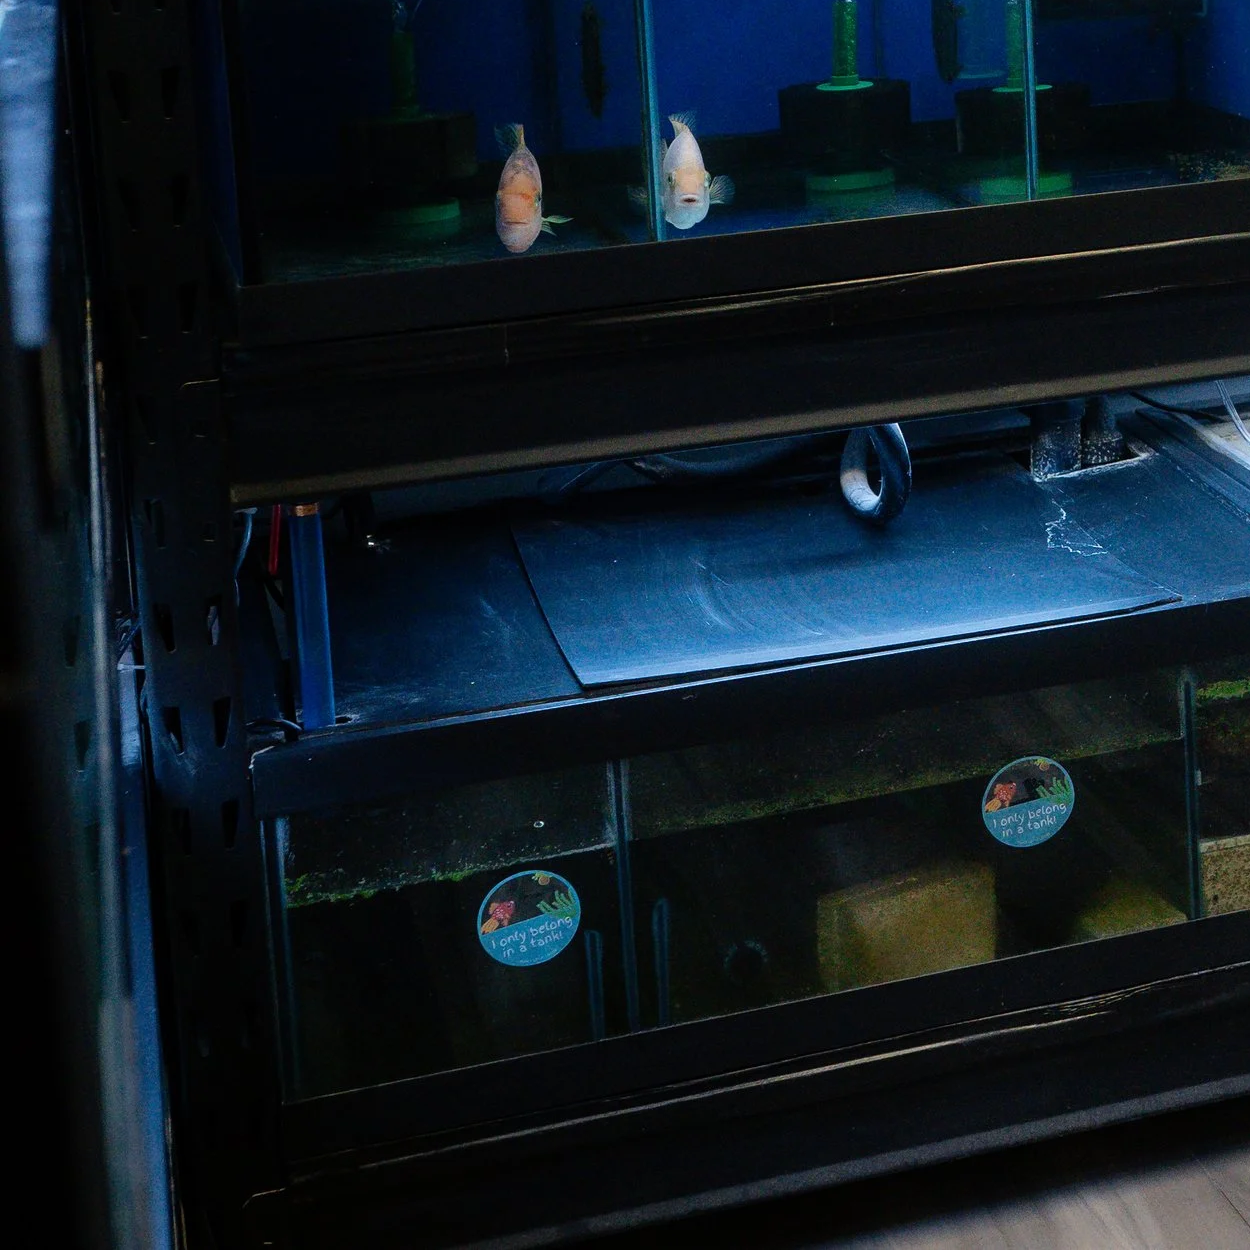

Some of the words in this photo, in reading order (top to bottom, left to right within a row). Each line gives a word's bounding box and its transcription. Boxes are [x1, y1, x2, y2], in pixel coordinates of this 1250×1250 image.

[992, 819, 996, 829] I
[1000, 813, 1025, 826] only
[1028, 803, 1067, 819] belong
[1002, 828, 1013, 838] in
[1017, 826, 1024, 834] a
[1027, 815, 1056, 830] tank!
[491, 940, 496, 949] I
[500, 931, 526, 947] only
[530, 917, 573, 936] belong
[503, 946, 514, 958] in
[530, 931, 563, 947] tank!
